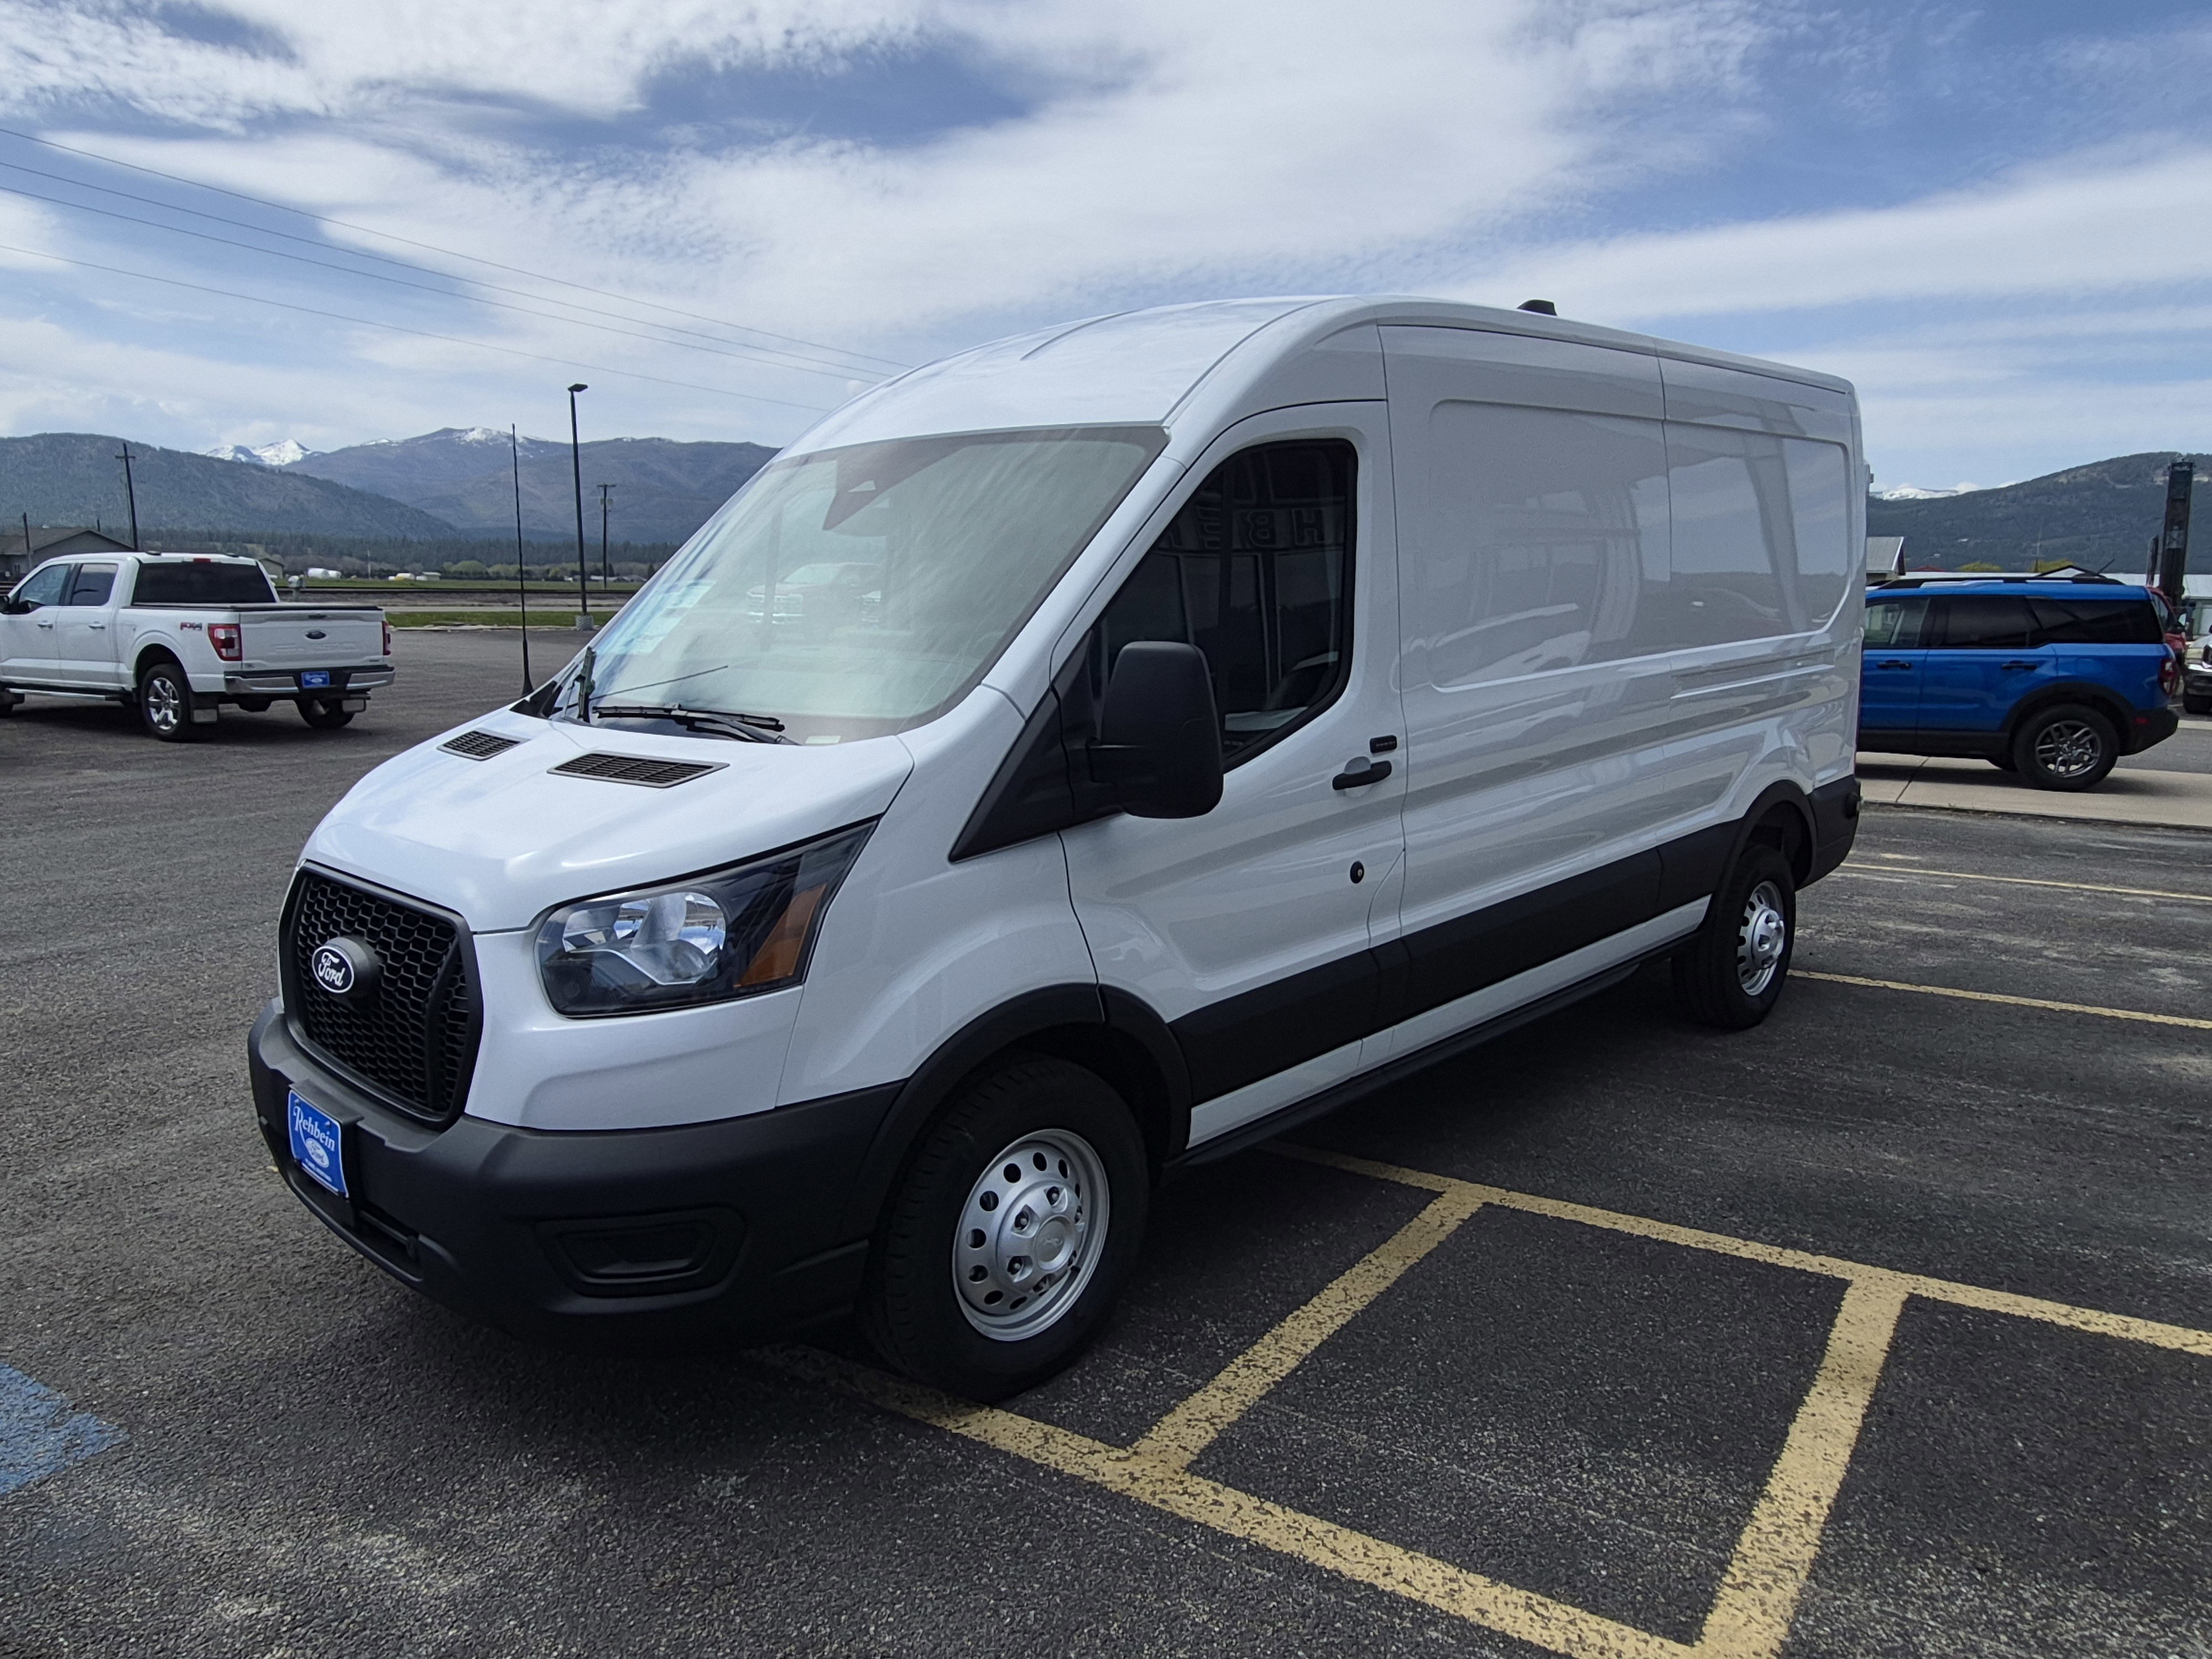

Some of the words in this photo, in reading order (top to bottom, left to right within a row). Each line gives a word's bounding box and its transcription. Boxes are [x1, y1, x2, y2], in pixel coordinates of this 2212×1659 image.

[180, 622, 202, 632] FX4
[318, 952, 346, 987] Ford
[293, 1105, 335, 1152] Rehbein
